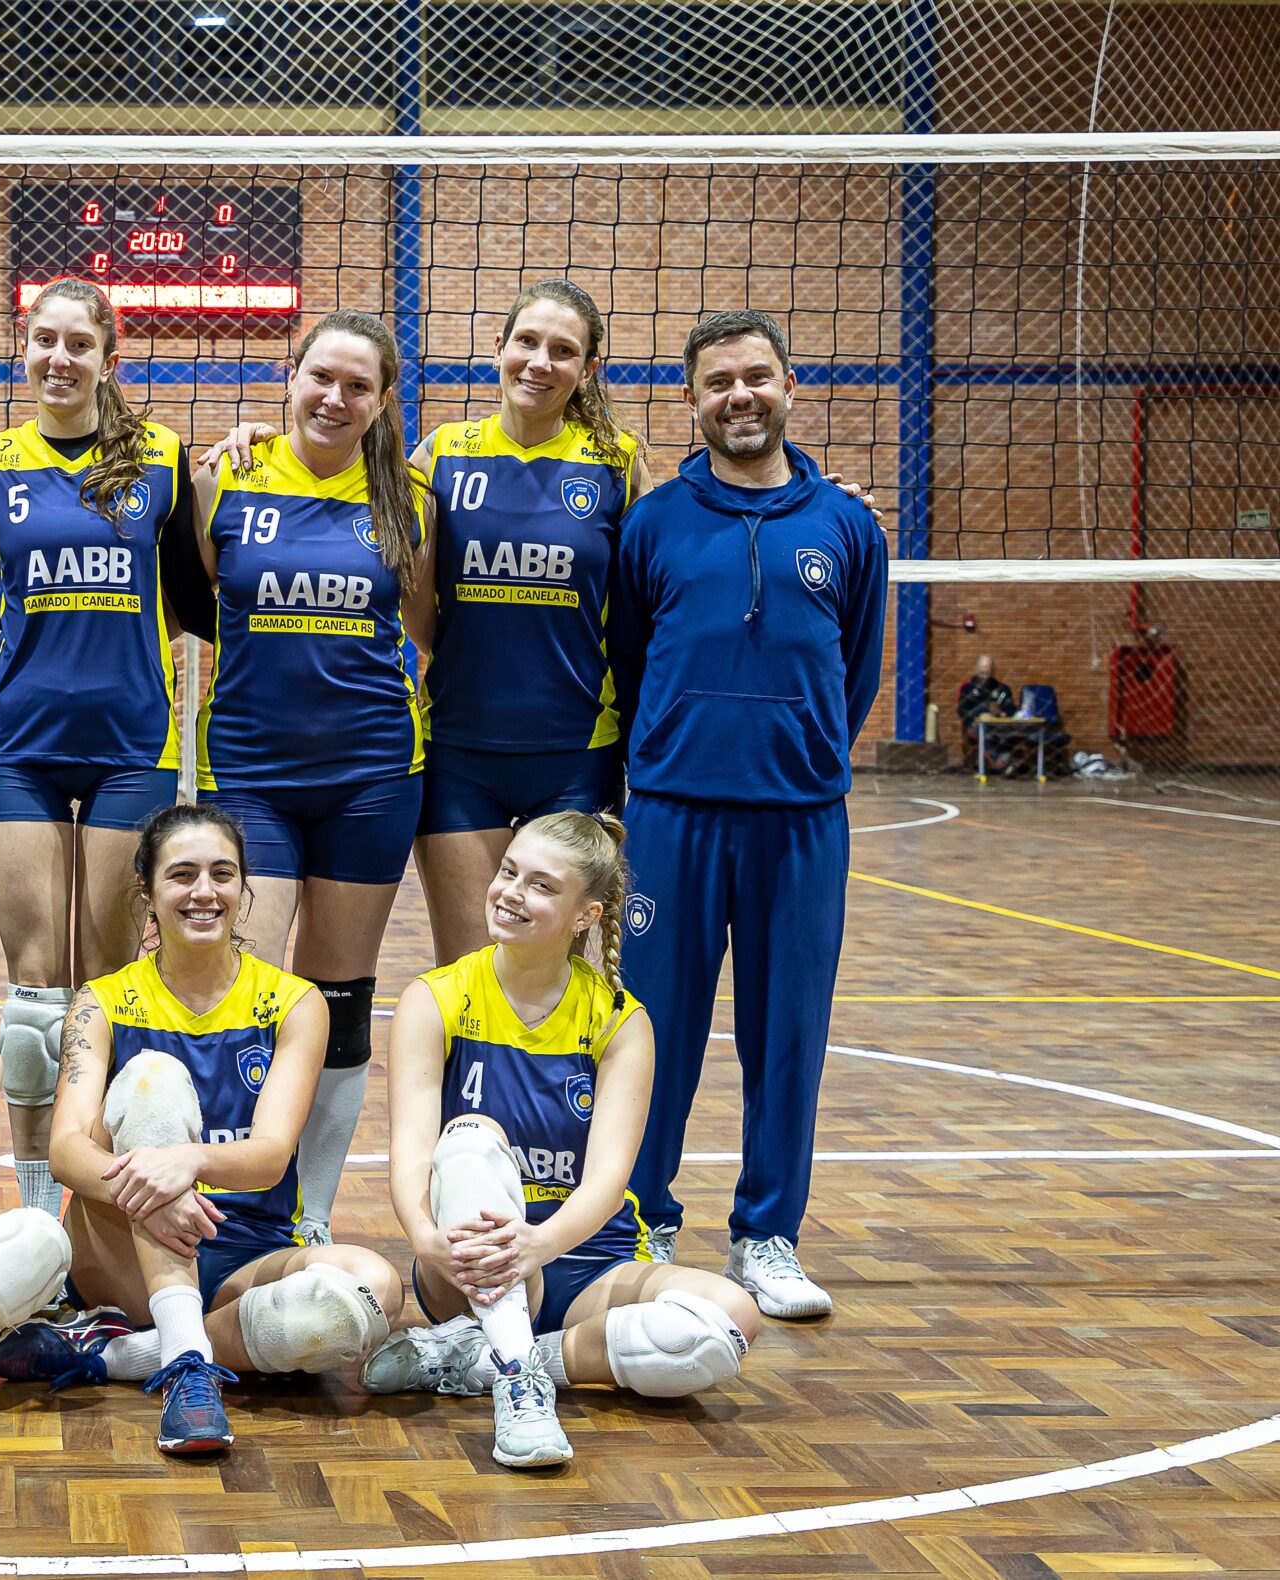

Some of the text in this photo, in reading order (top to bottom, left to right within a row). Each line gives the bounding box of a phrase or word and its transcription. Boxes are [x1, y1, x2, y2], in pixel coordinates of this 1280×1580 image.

[219, 204, 232, 223] 0
[130, 232, 184, 251] 20:00
[8, 483, 30, 524] 5
[450, 471, 489, 511] 10
[241, 506, 281, 545] 19
[27, 546, 132, 587] AABB
[463, 540, 575, 580] AABB
[25, 596, 71, 609] RAMADO
[81, 596, 125, 608] CANELA
[127, 598, 140, 609] RS
[257, 571, 373, 610] AABB
[517, 588, 561, 602] CANELA
[563, 592, 577, 604] RS
[250, 618, 303, 629] GRAMADO
[315, 619, 359, 632] CANELA
[361, 623, 373, 634] RS
[461, 1061, 484, 1109] 4
[456, 1121, 480, 1129] asics
[510, 1145, 576, 1185] ABB
